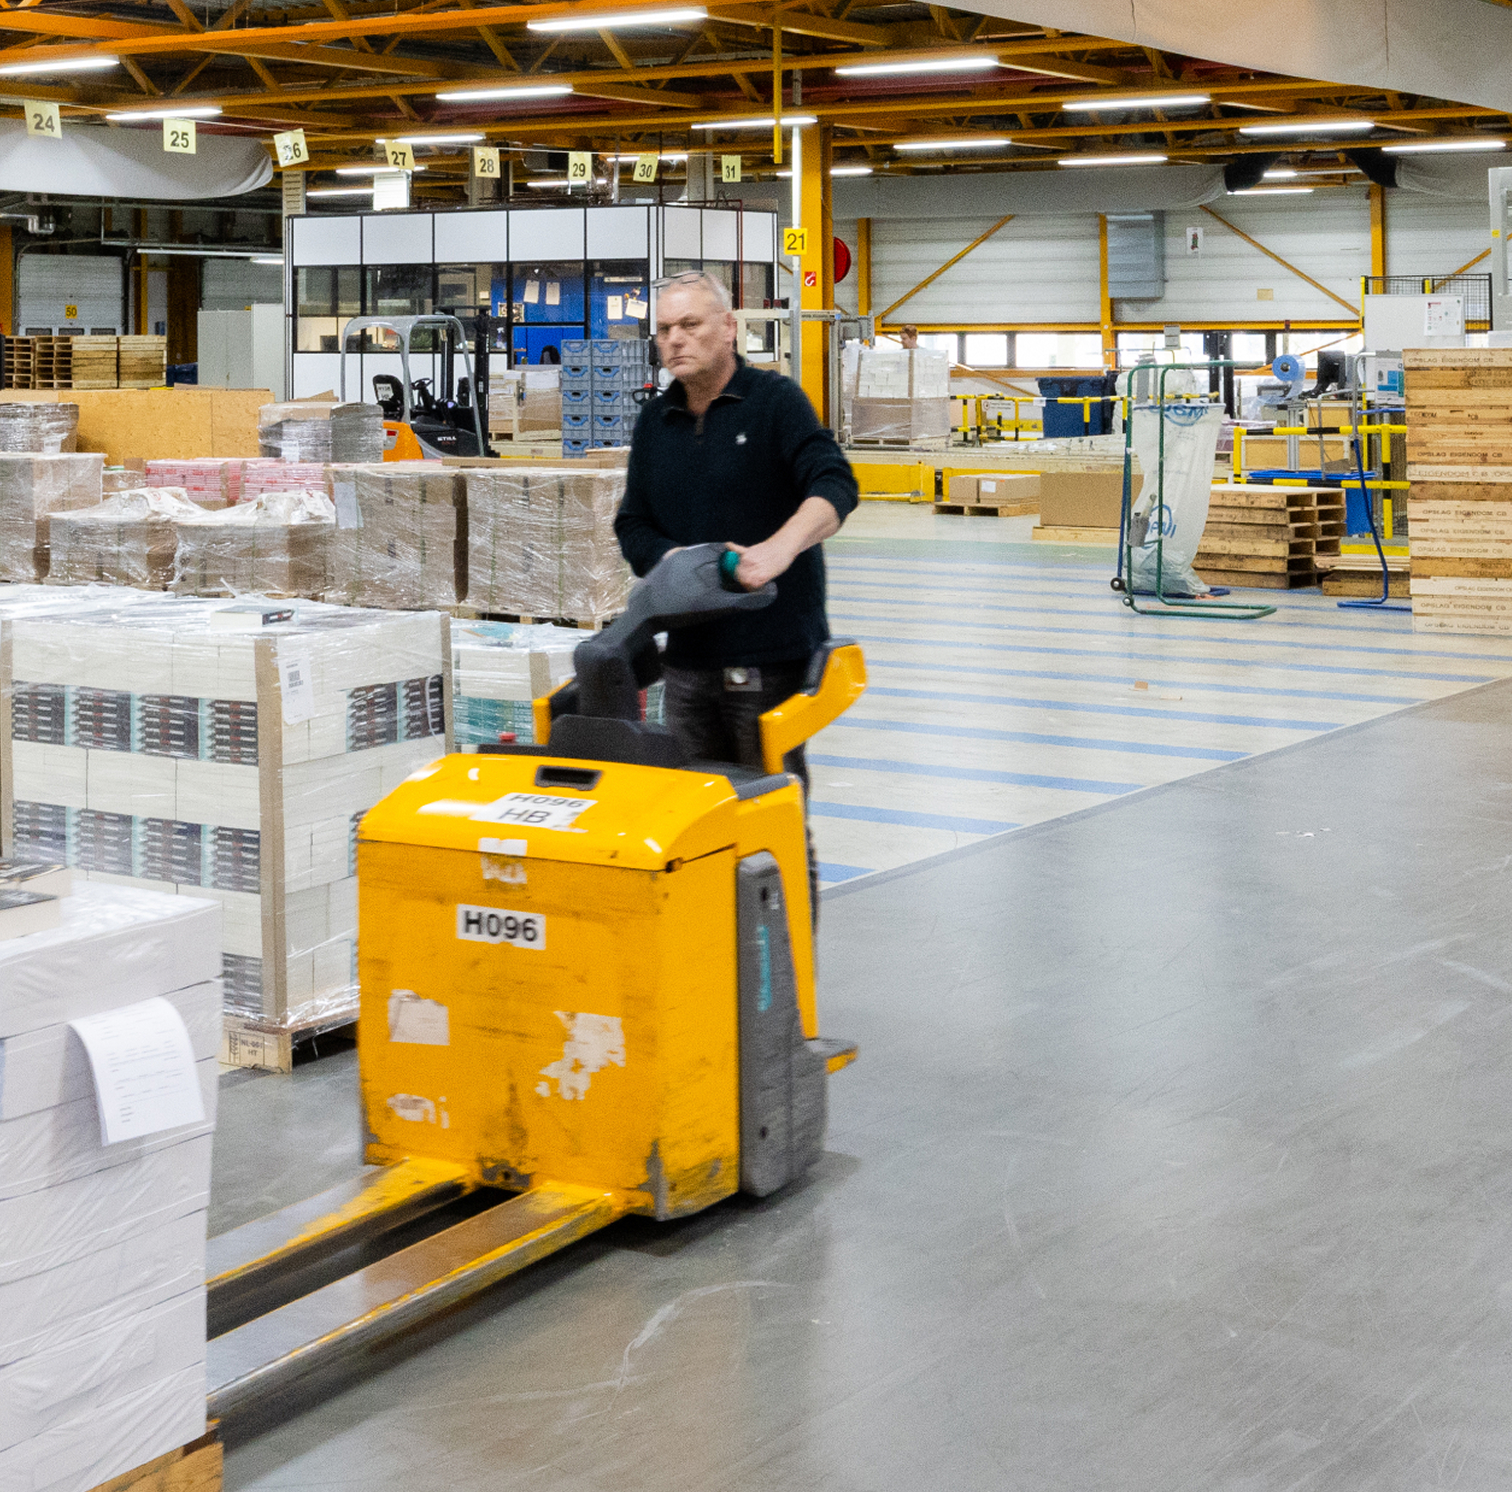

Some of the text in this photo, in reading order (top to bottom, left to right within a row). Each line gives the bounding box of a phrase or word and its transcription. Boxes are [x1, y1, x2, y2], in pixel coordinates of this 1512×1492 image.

[33, 114, 54, 132] 24
[170, 131, 189, 148] 25
[283, 143, 301, 161] 26
[391, 151, 406, 166] 27
[480, 158, 494, 173] 28
[573, 163, 585, 177] 29
[639, 164, 652, 177] 30
[726, 165, 735, 178] 31
[787, 233, 805, 250] 21
[509, 794, 588, 808] H096
[497, 808, 552, 823] HB
[463, 910, 538, 942] H096
